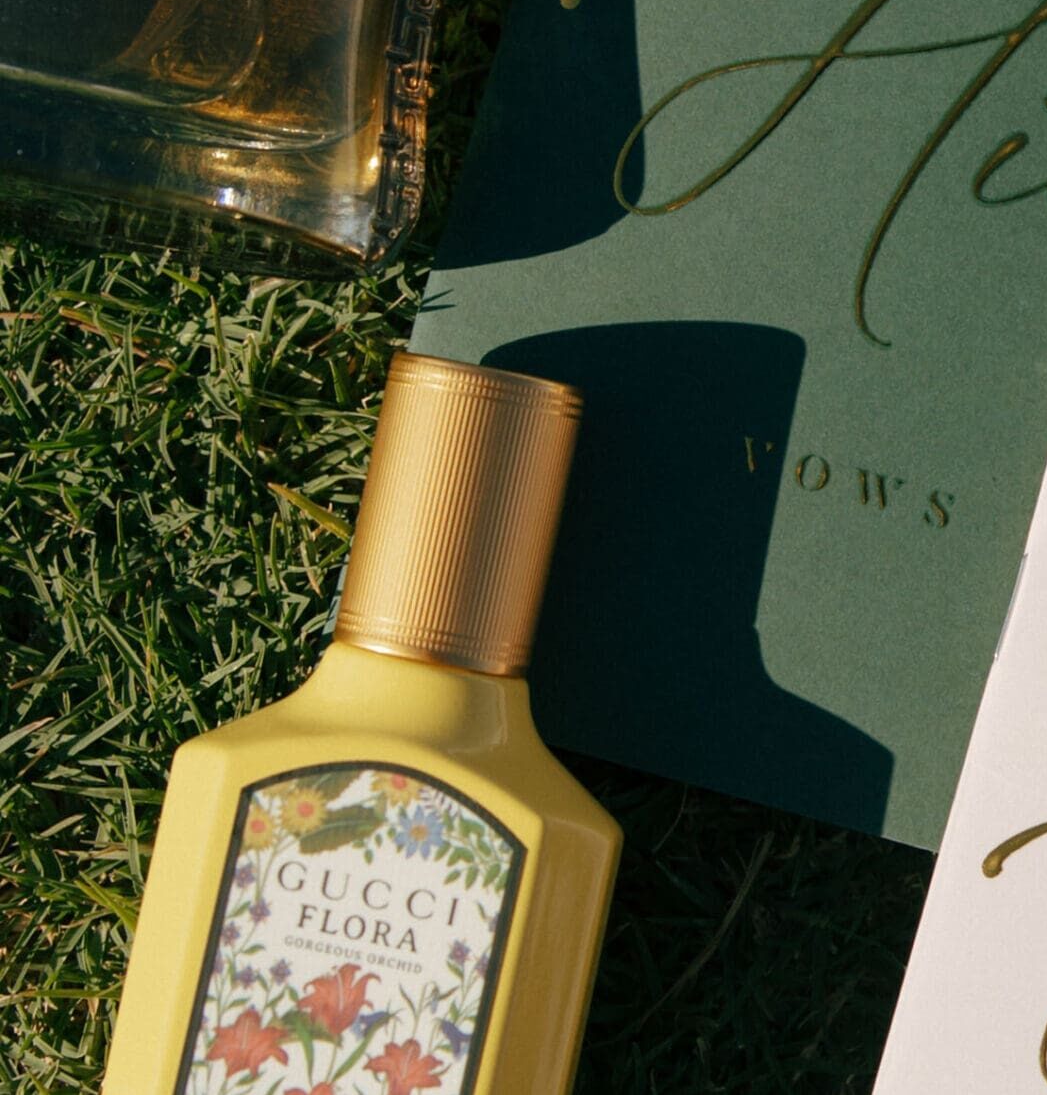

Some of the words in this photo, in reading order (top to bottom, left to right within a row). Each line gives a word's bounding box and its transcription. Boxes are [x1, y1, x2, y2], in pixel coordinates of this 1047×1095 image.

[277, 861, 458, 926] GUCCI
[298, 904, 417, 953] FLORA
[284, 935, 361, 961] GORGEOUS
[367, 951, 423, 974] ORCHID
